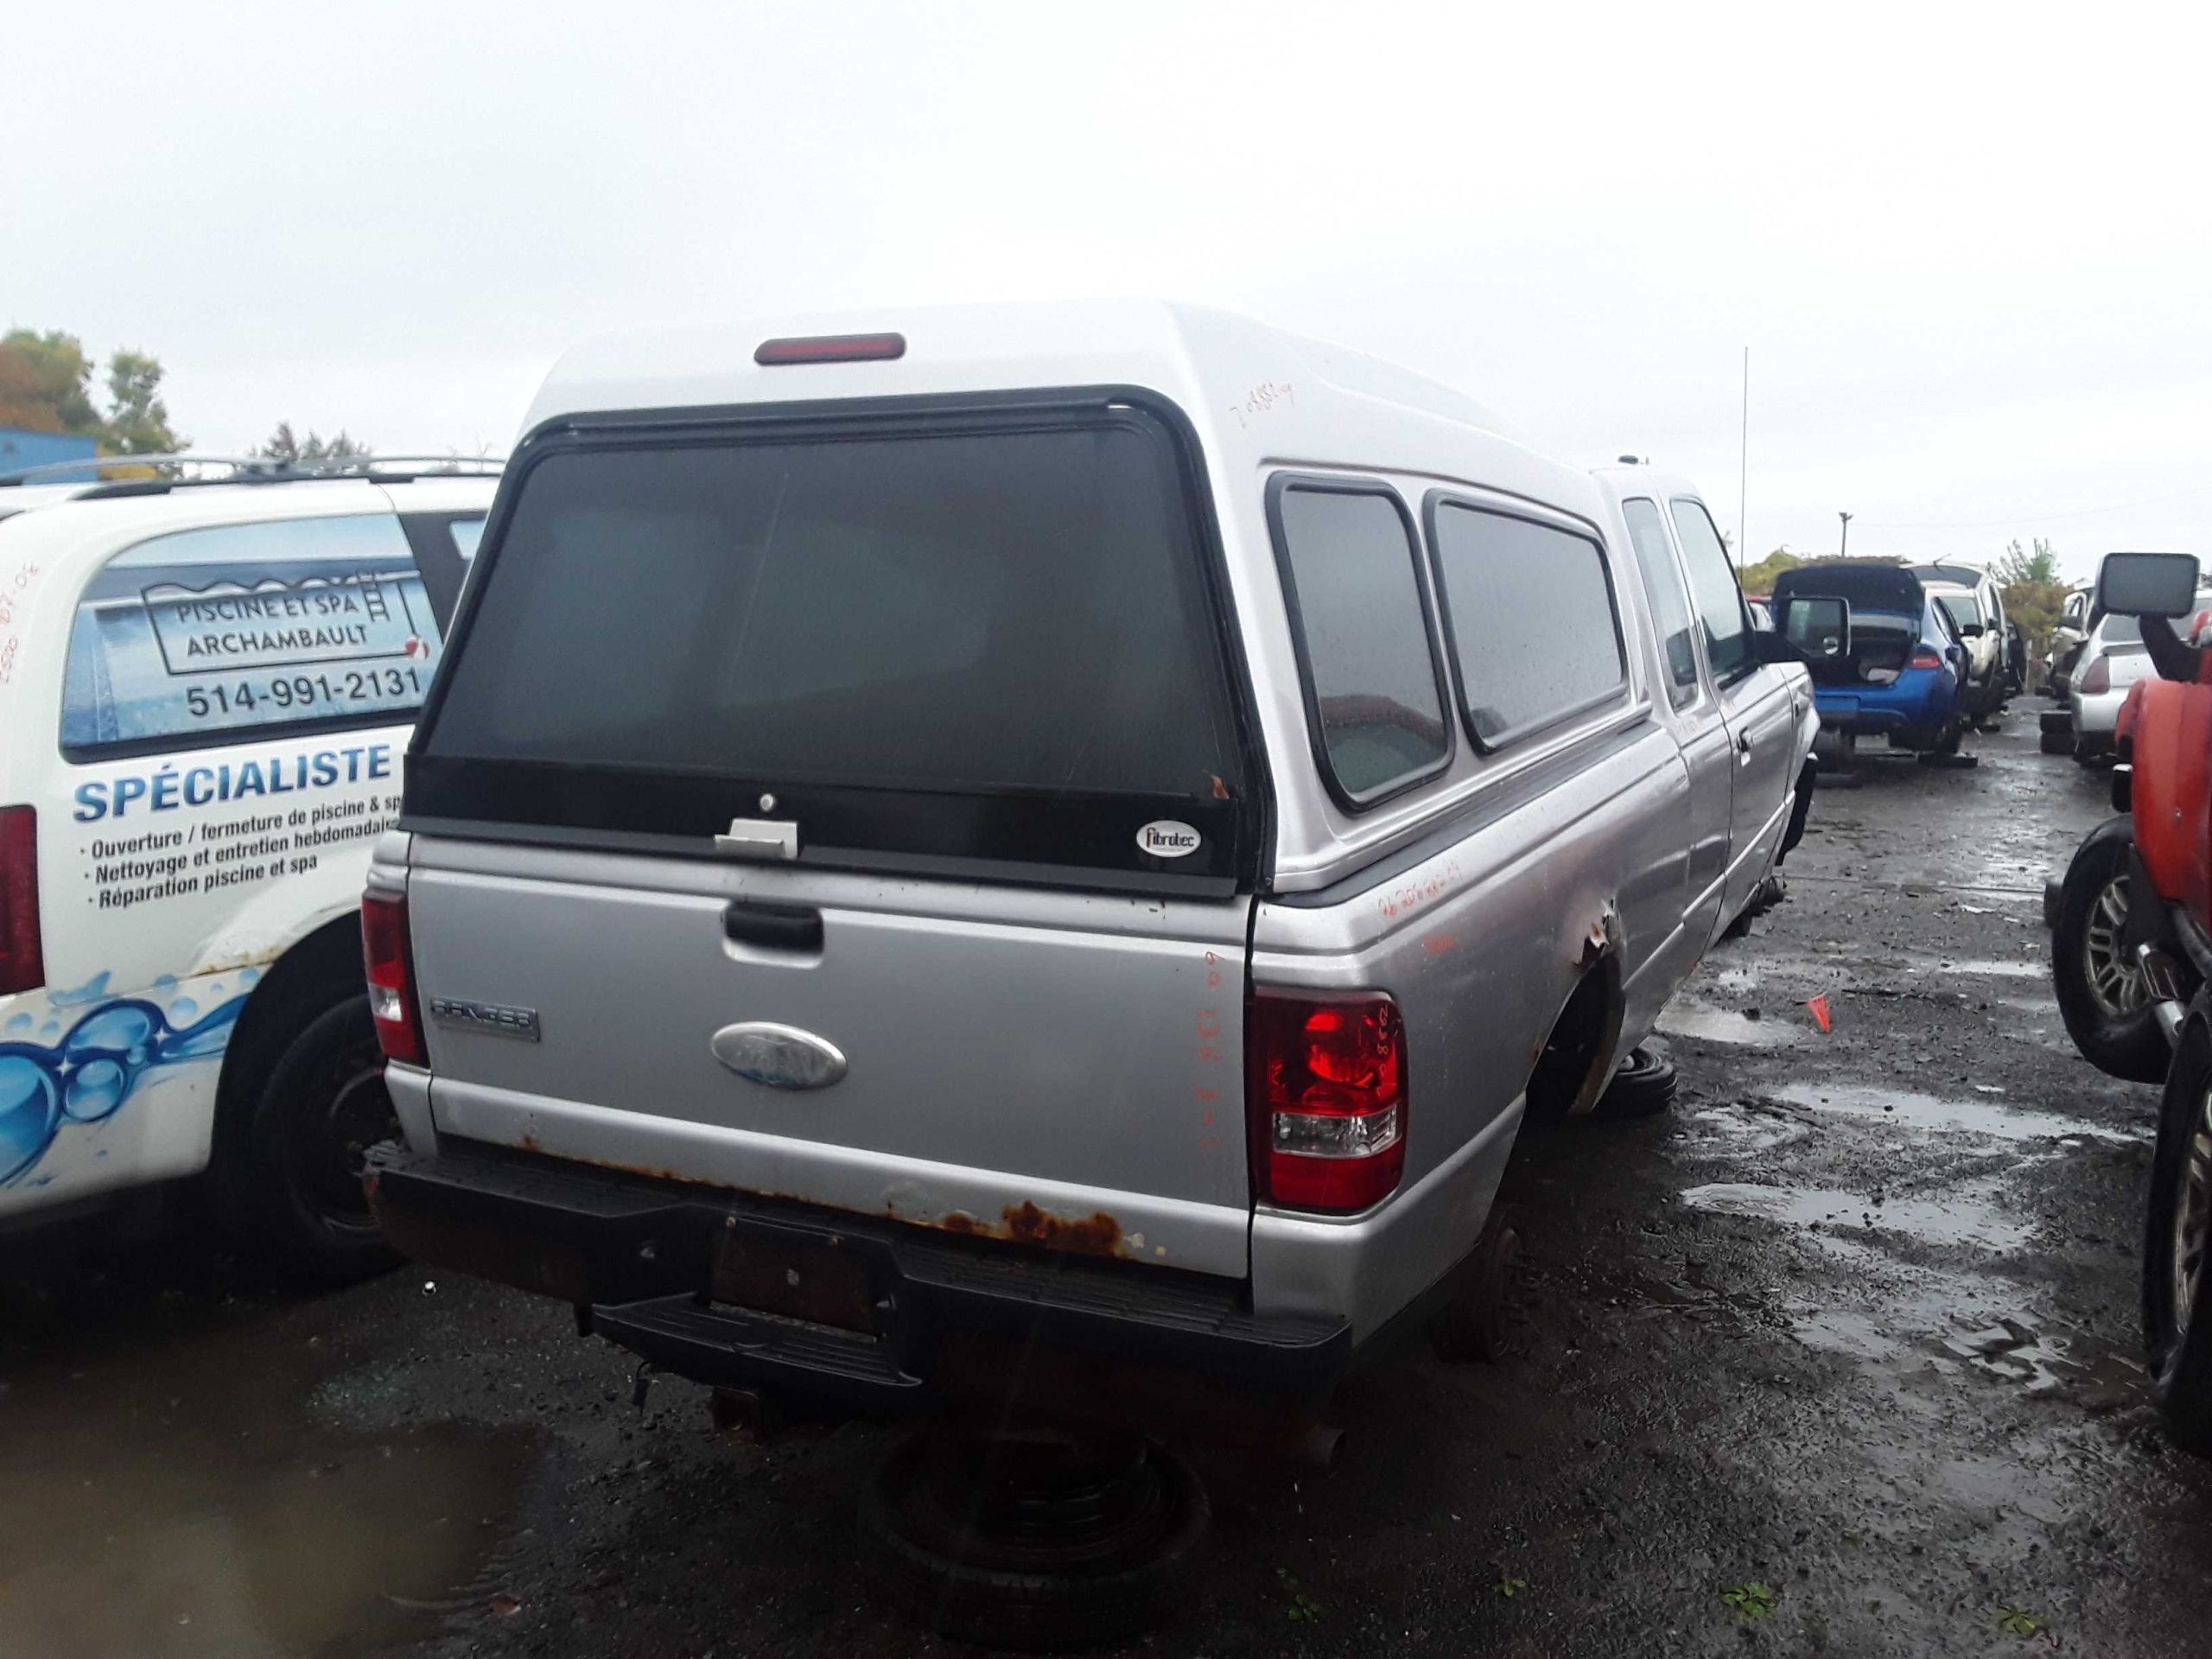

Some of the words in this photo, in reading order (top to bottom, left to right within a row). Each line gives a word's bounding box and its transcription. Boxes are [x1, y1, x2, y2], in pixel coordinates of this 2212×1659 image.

[177, 599, 278, 623] PISCINE
[283, 598, 308, 617] ET
[315, 594, 359, 615] SPA
[187, 625, 368, 658] ARCHAMBAULT
[187, 667, 421, 716] 514-991-2131
[73, 744, 391, 823] SPÉCIALISTE
[92, 830, 183, 860] Ouverture
[200, 814, 283, 841] fermeture
[288, 807, 306, 827] de
[311, 799, 365, 826] piscine
[369, 795, 380, 812] &
[385, 795, 401, 811] sp
[96, 854, 188, 885] Nettoyage
[193, 847, 209, 866] et
[215, 836, 289, 862] entretien
[99, 876, 199, 909] Réparation
[204, 864, 265, 893] piscine
[270, 858, 285, 875] et
[289, 854, 318, 875] spa
